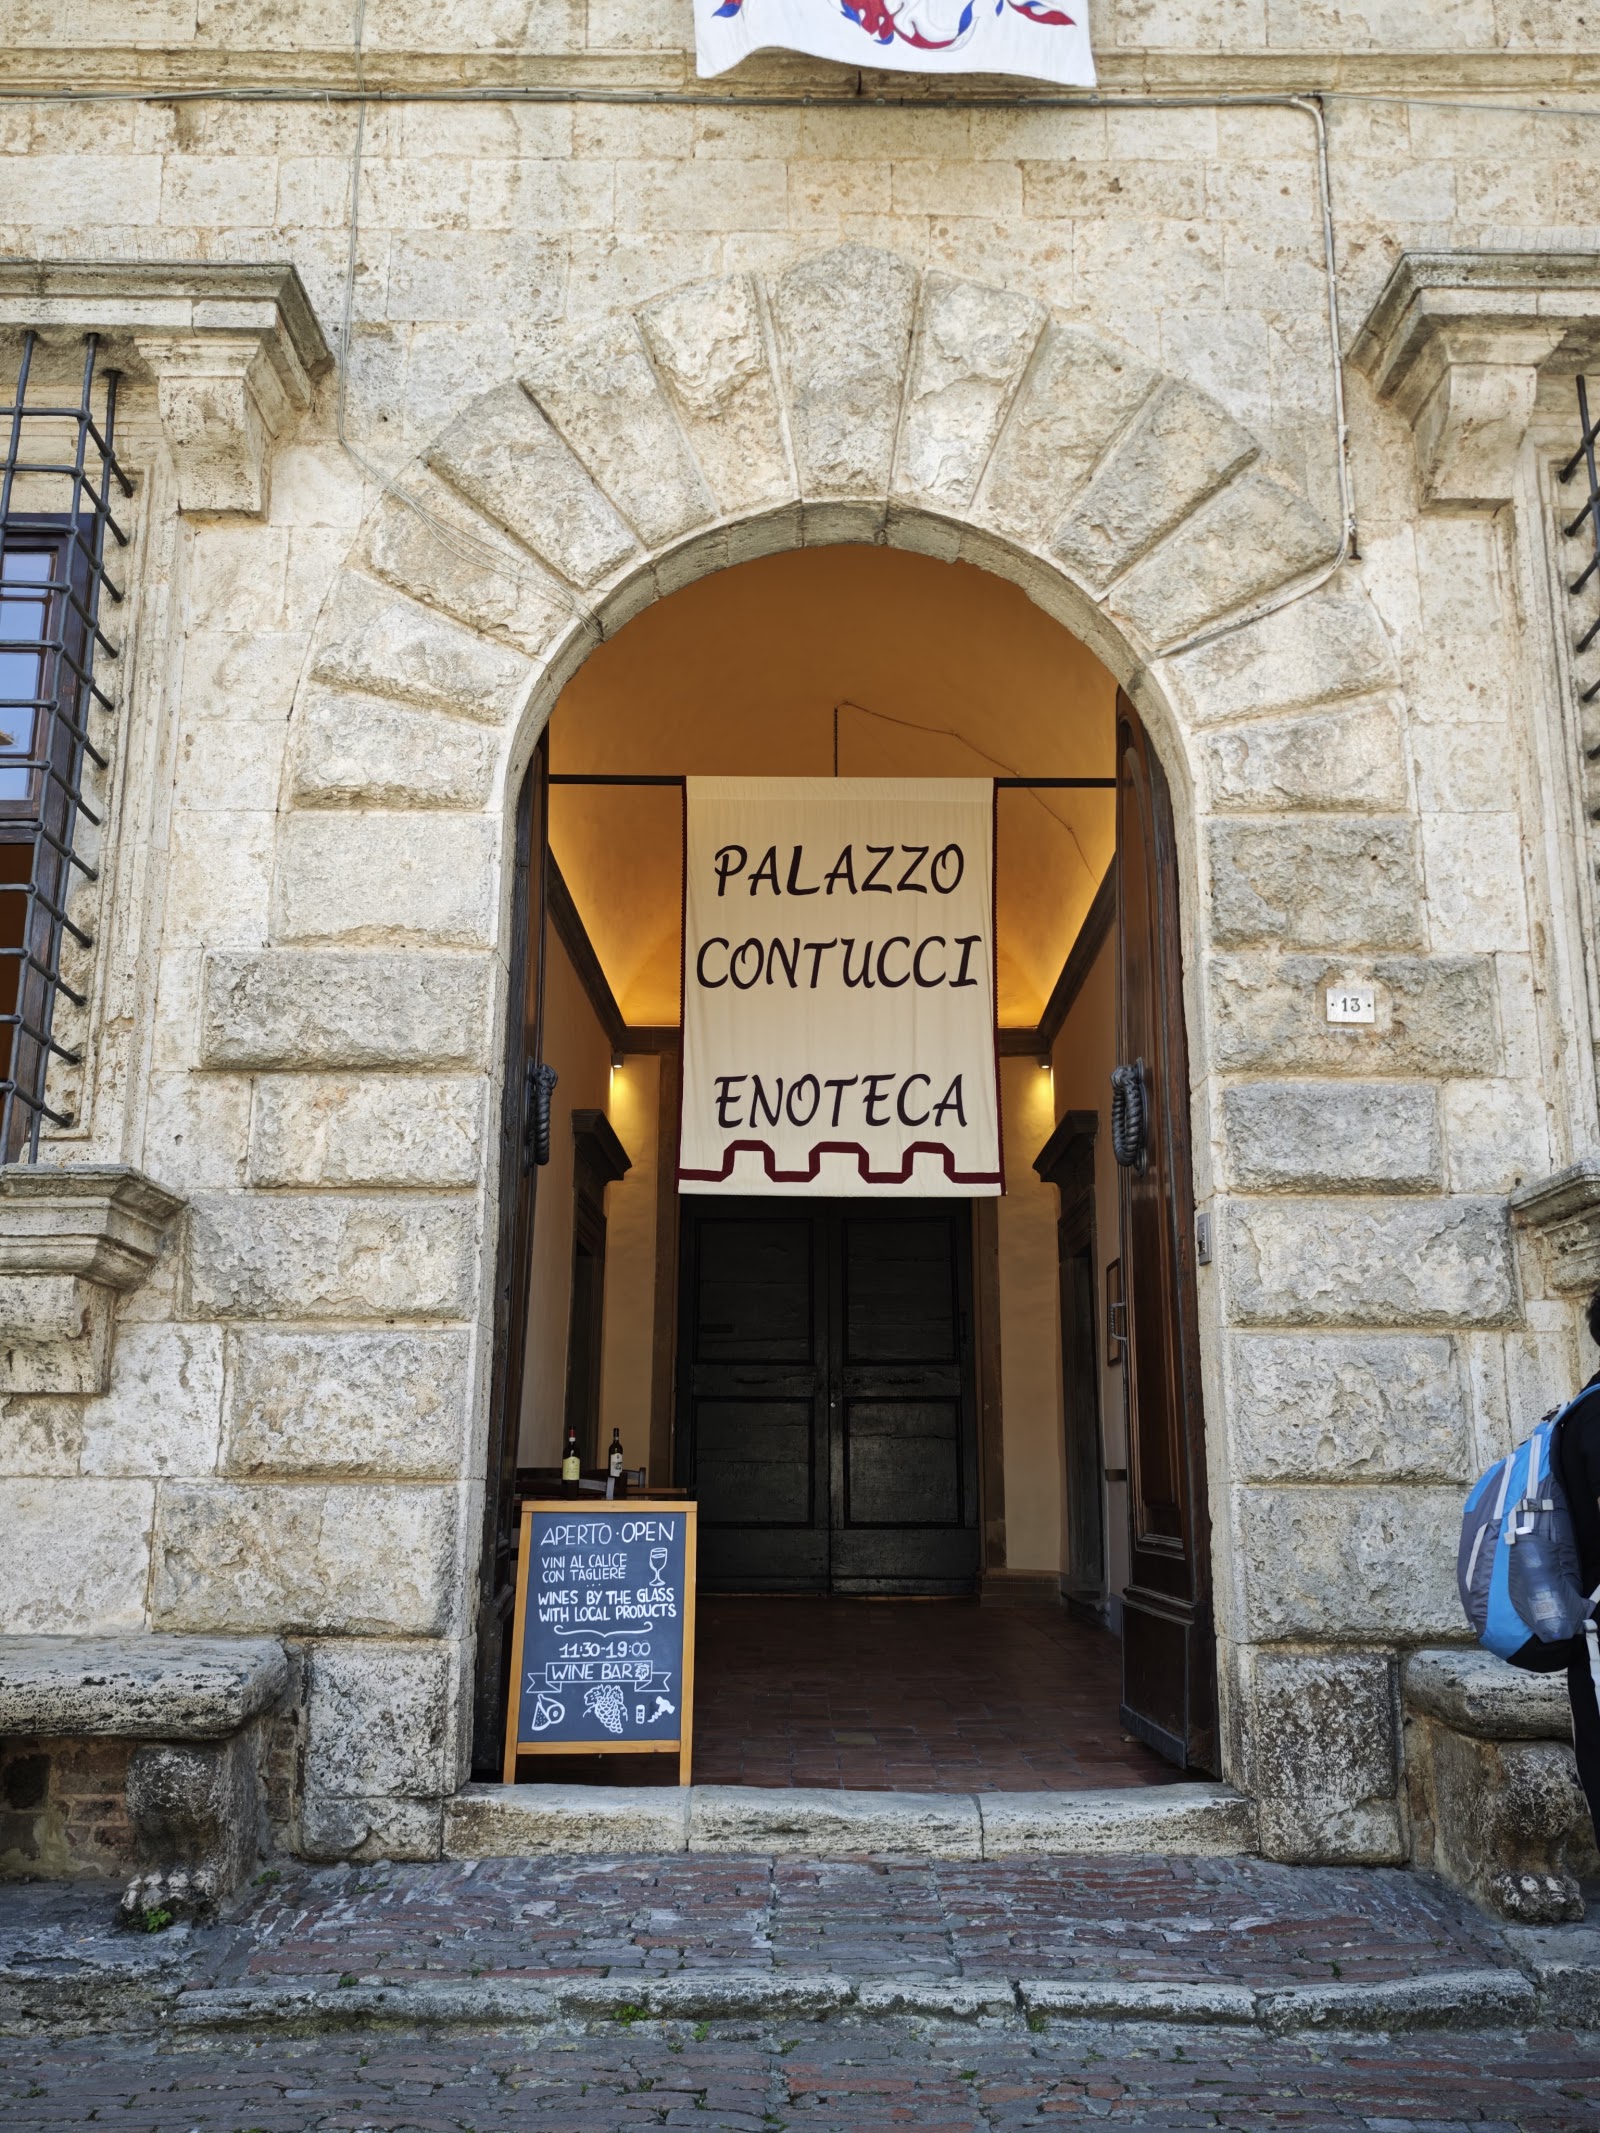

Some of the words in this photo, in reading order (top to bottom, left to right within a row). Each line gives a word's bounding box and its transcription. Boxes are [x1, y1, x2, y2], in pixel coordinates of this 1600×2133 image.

[714, 843, 964, 896] PALAZZO
[697, 935, 982, 989] CONTUCCI
[1341, 997, 1361, 1012] 13
[714, 1073, 968, 1128] ENOTECA
[541, 1523, 612, 1546] APERTO
[621, 1521, 675, 1543] OPEN
[542, 1556, 565, 1569] VINI
[570, 1555, 585, 1568] AL
[589, 1553, 628, 1568] CALICE
[542, 1570, 565, 1583] CON
[570, 1567, 626, 1581] TAGLIERE
[538, 1590, 578, 1606] WINES
[587, 1590, 603, 1605] BY
[606, 1590, 632, 1605] THE
[637, 1588, 674, 1602] GLASS
[539, 1606, 569, 1622] WITH
[574, 1606, 610, 1621] LOCAL
[616, 1604, 677, 1619] PRODUCTS
[559, 1641, 651, 1658] 11:30-19:00
[551, 1664, 594, 1680] WINE
[601, 1663, 633, 1679] BAR
